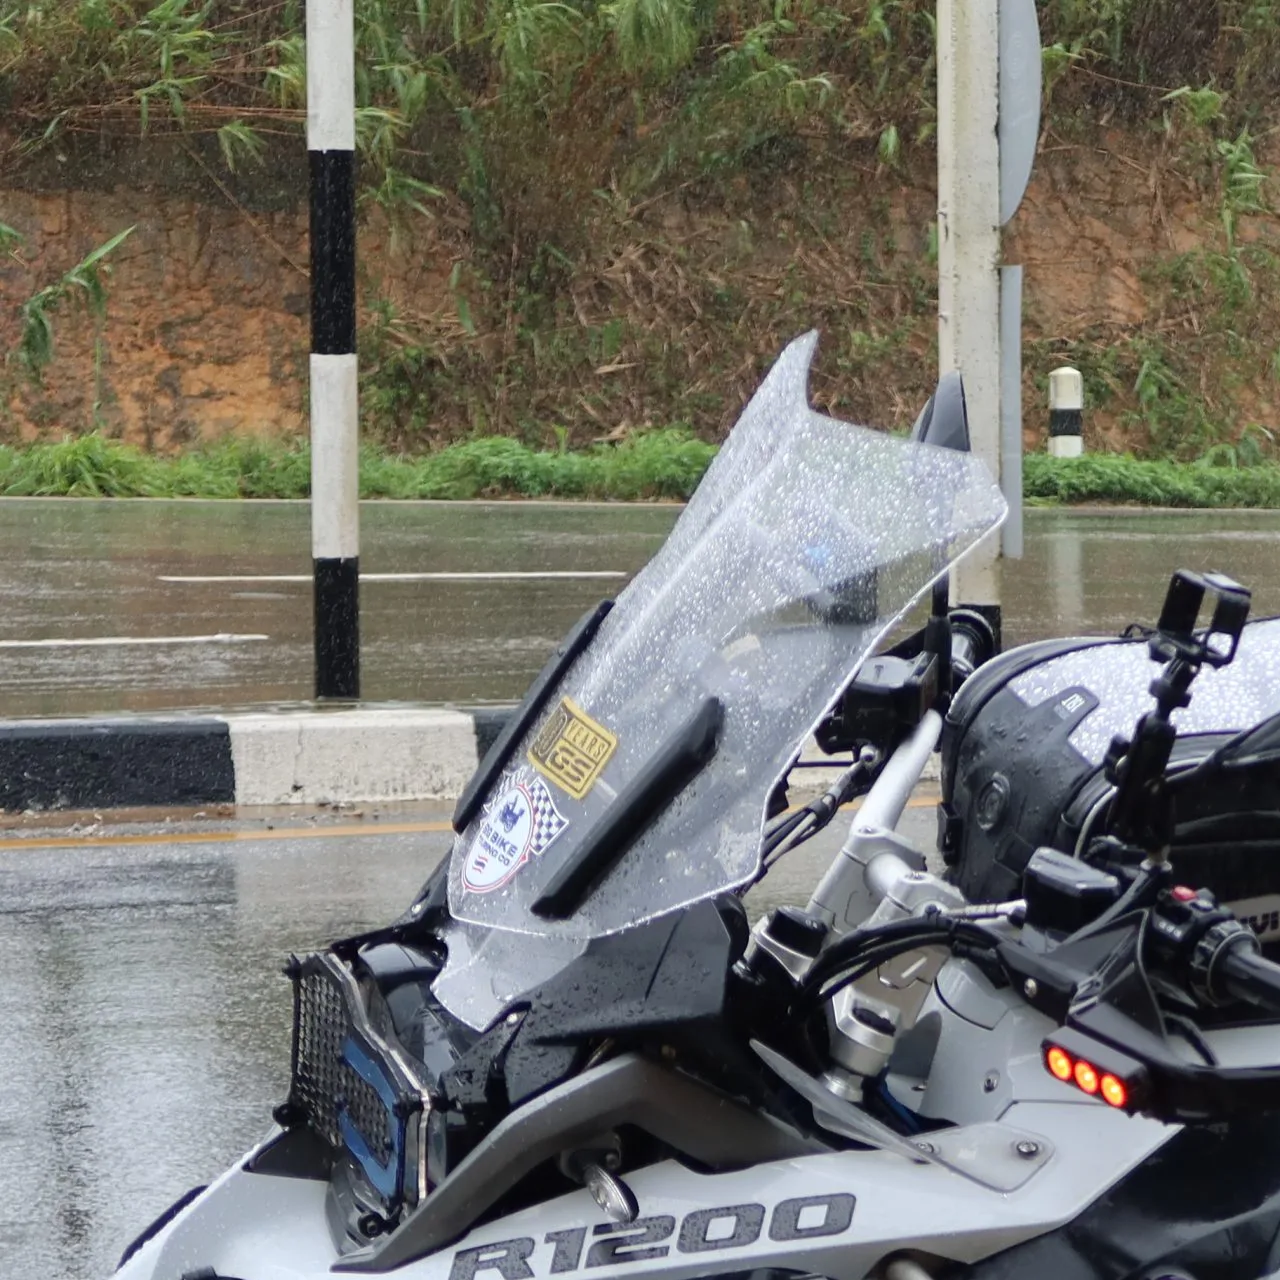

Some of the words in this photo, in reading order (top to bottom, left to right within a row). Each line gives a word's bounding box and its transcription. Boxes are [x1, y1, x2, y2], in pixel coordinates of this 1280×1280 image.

[566, 719, 606, 759] YEARS
[549, 745, 592, 782] GS
[491, 831, 518, 858] BIKE
